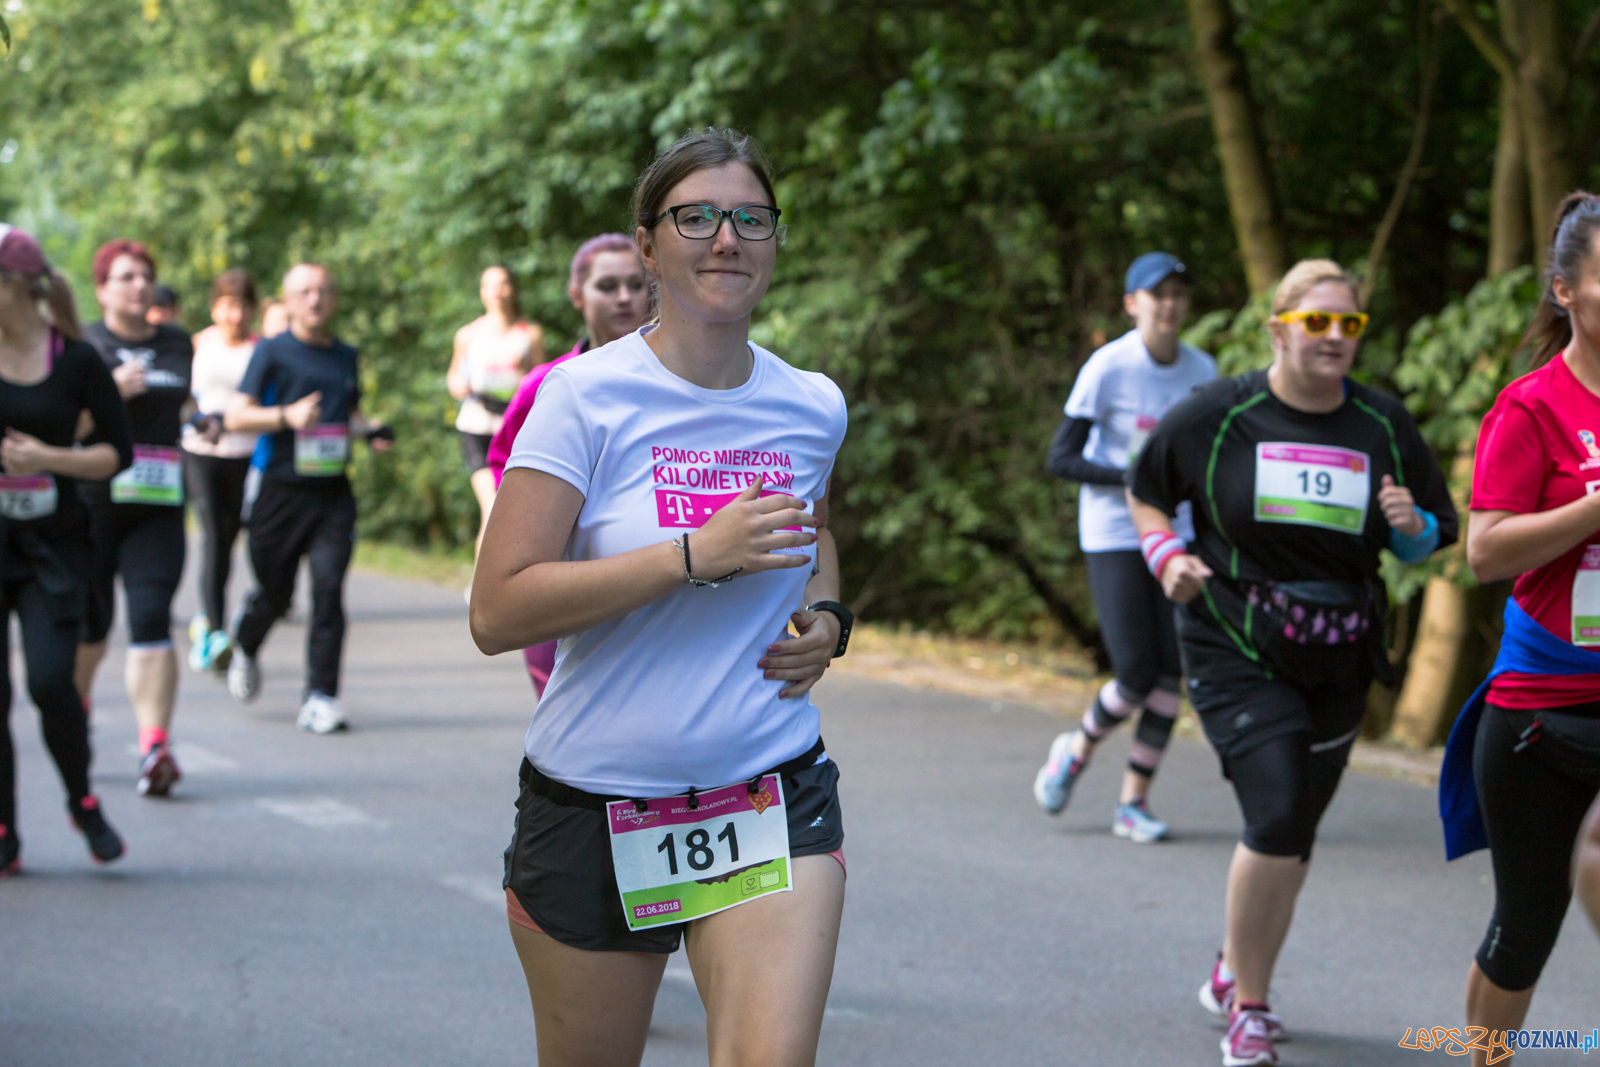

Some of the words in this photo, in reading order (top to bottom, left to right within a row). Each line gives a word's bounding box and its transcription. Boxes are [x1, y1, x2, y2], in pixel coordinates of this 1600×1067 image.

[652, 446, 711, 464] POMOC
[714, 449, 792, 470] MIERZONA
[653, 465, 795, 490] KILOMETRAMI
[1297, 470, 1332, 496] 19
[670, 797, 738, 814] BIEGCKOLADOWY.PL
[657, 822, 740, 876] 181
[635, 902, 679, 917] 22.06.2018
